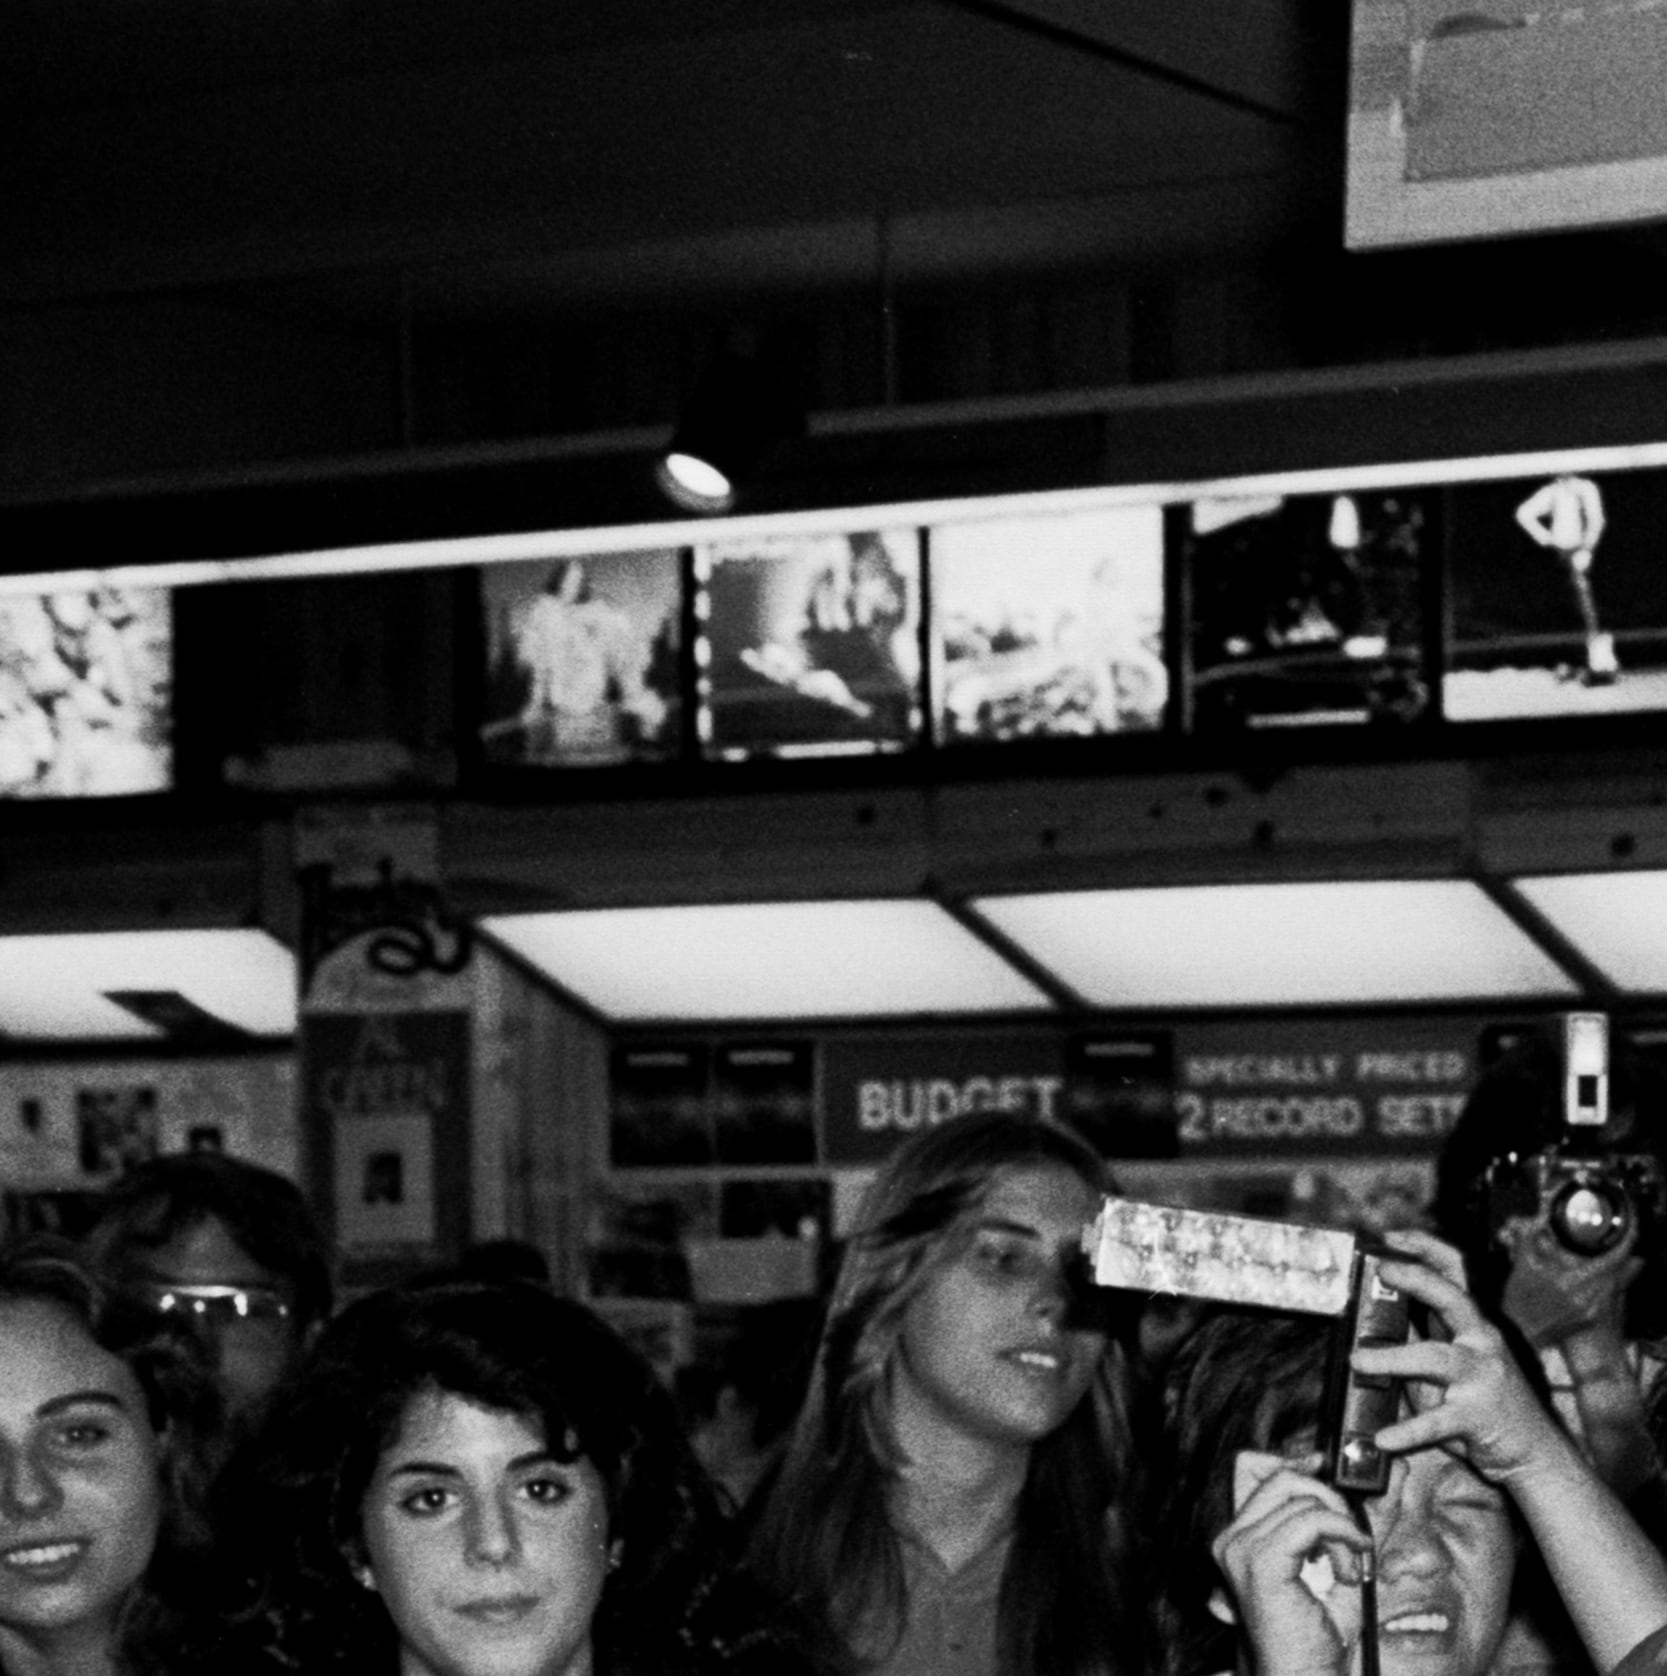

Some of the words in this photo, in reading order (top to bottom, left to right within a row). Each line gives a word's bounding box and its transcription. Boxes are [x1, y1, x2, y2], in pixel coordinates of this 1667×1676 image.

[1184, 1053, 1342, 1086] SPECIALLY
[1356, 1050, 1467, 1082] PRICED
[1174, 1092, 1207, 1142] 2
[1211, 1096, 1364, 1138] RECORD
